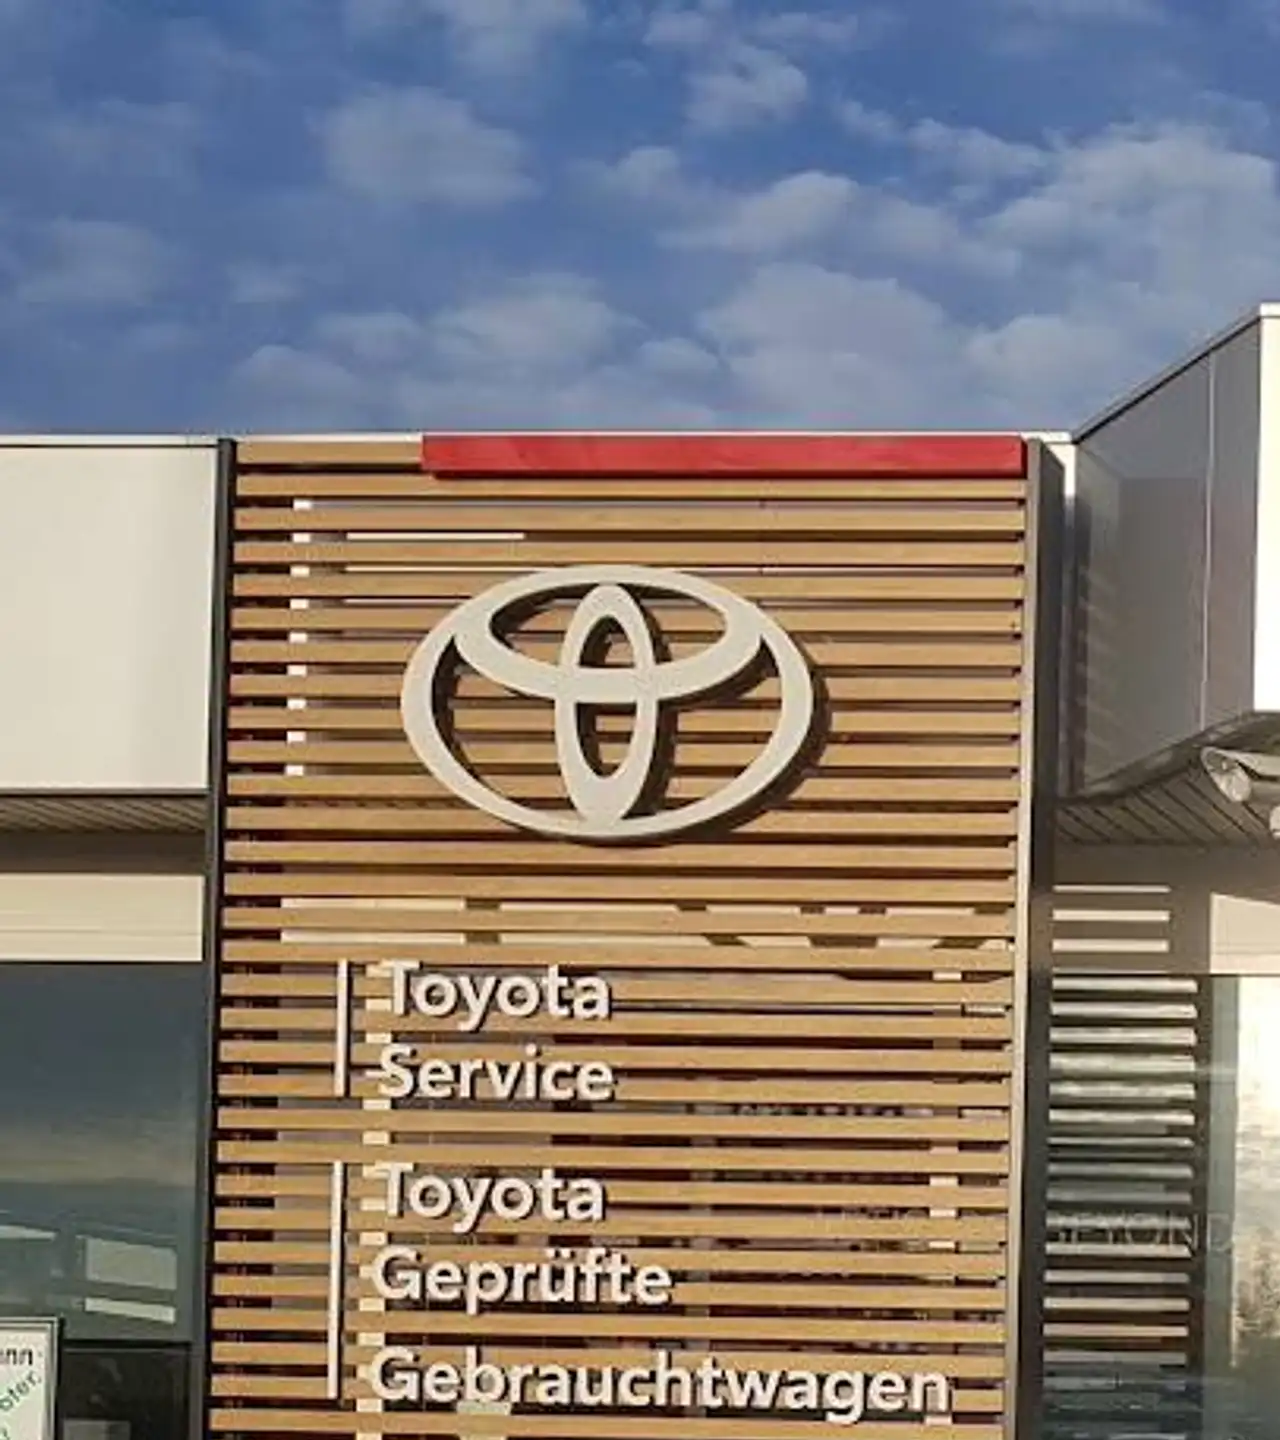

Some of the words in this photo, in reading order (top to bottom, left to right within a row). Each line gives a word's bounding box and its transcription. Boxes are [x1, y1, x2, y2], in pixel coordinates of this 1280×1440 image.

[384, 959, 611, 1031] Toyota
[379, 1043, 613, 1100] Service
[375, 1161, 605, 1233] Toyota
[371, 1246, 673, 1315] Geprüfte
[369, 1348, 951, 1424] Gebrauchtwagen
